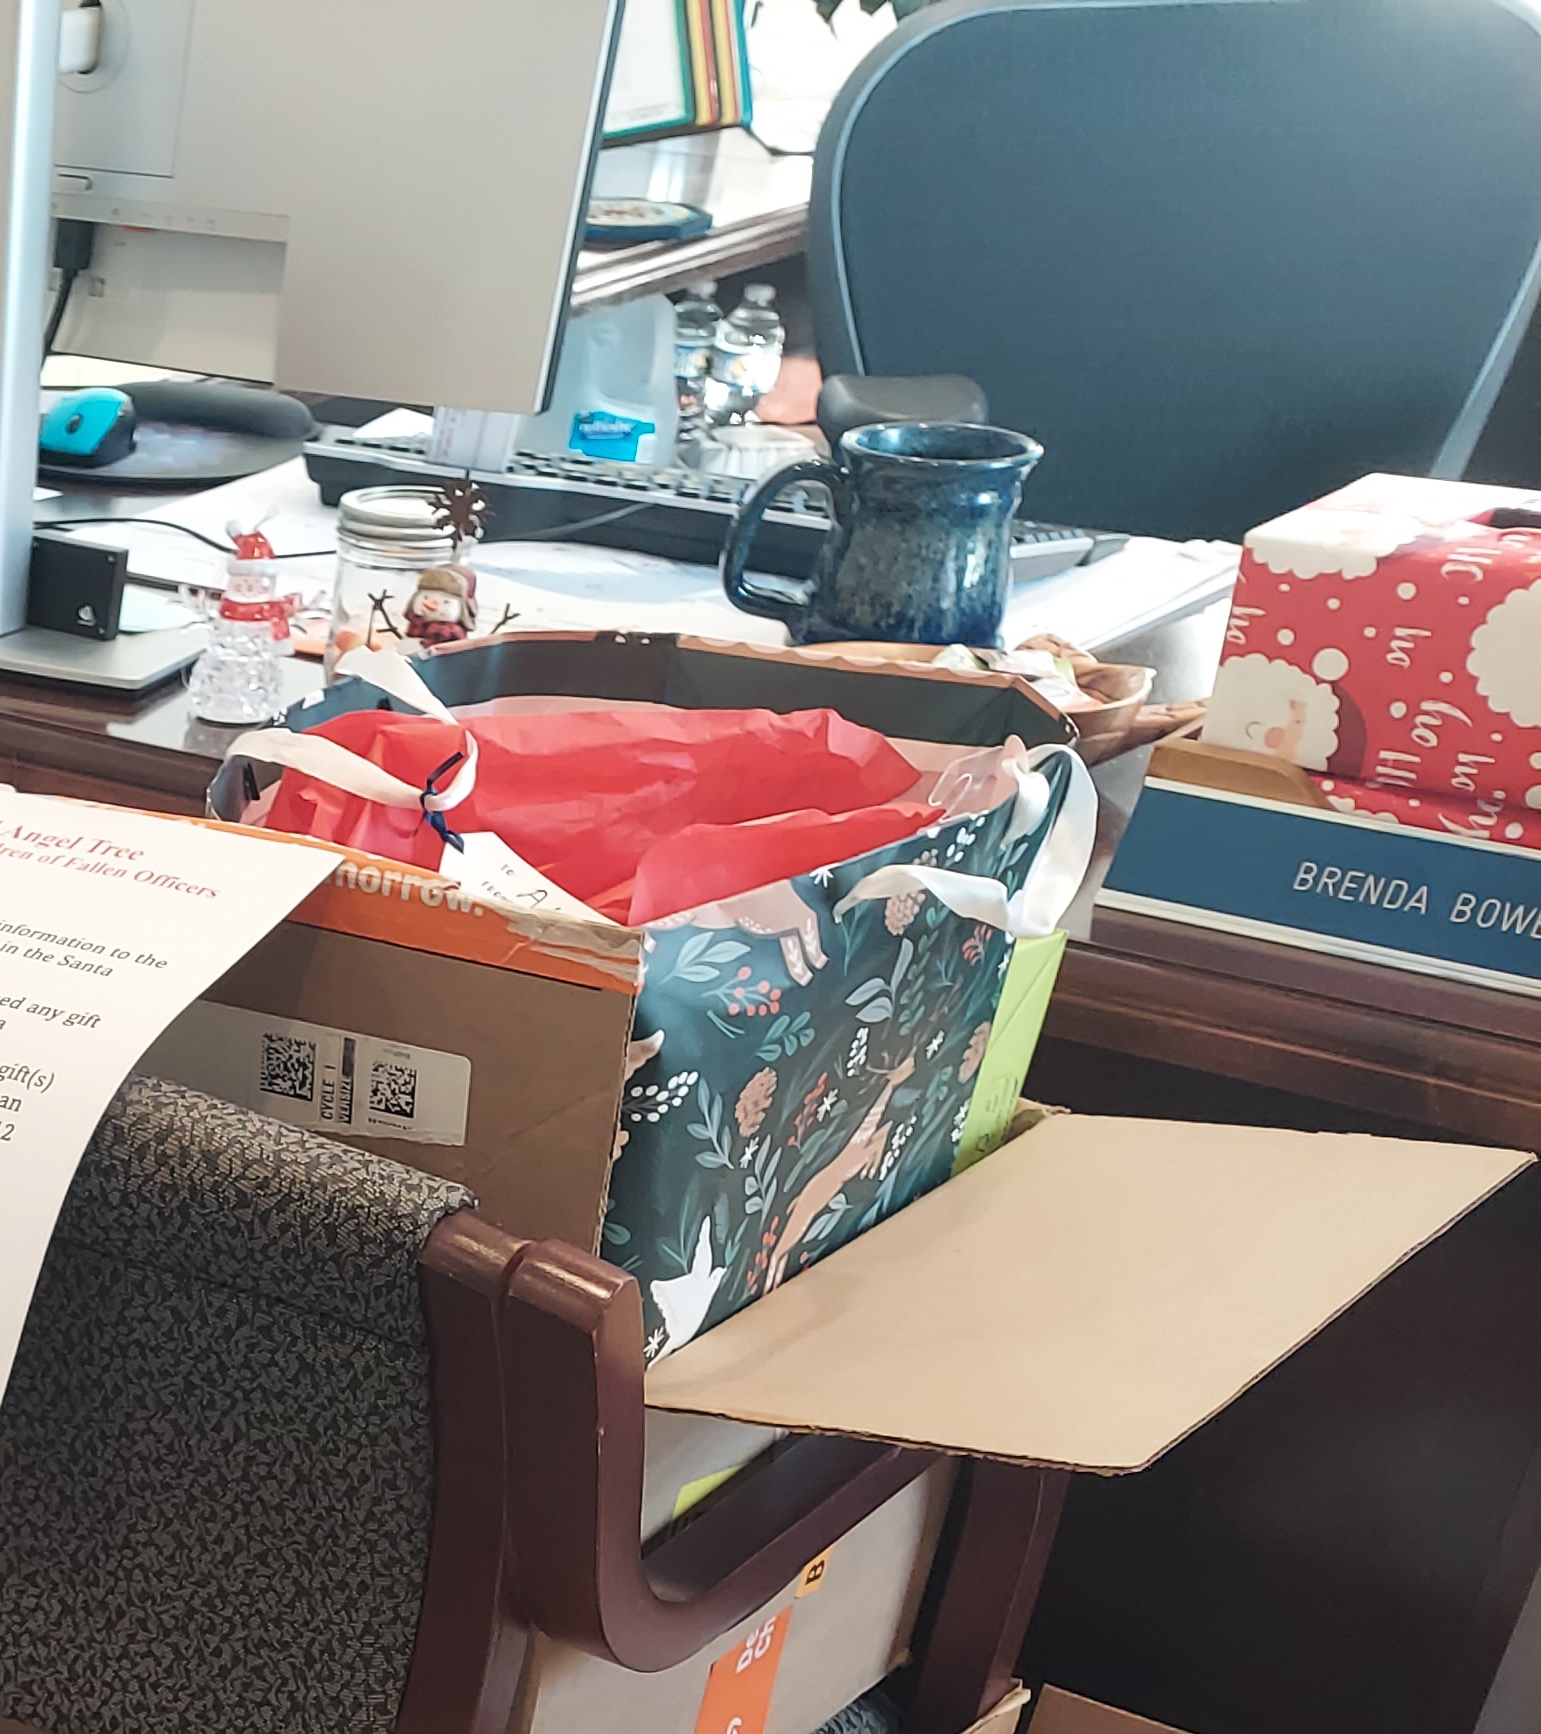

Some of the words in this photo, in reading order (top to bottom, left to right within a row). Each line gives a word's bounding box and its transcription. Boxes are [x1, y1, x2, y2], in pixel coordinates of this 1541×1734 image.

[1385, 626, 1432, 668] ho
[1410, 700, 1473, 747] ho
[2, 822, 82, 851] Angel
[86, 837, 144, 861] Tree
[35, 852, 62, 866] of
[60, 855, 128, 878] Fallen
[133, 869, 219, 898] Officers
[1293, 861, 1429, 915] BRENDA
[0, 941, 19, 956] in
[23, 945, 55, 964] the
[57, 954, 114, 977] Santa
[110, 947, 131, 960] to
[135, 952, 168, 970] the
[26, 1001, 66, 1022] any
[62, 1011, 102, 1030] gift
[321, 1079, 335, 1120] CYCLE
[805, 1560, 825, 1585] B
